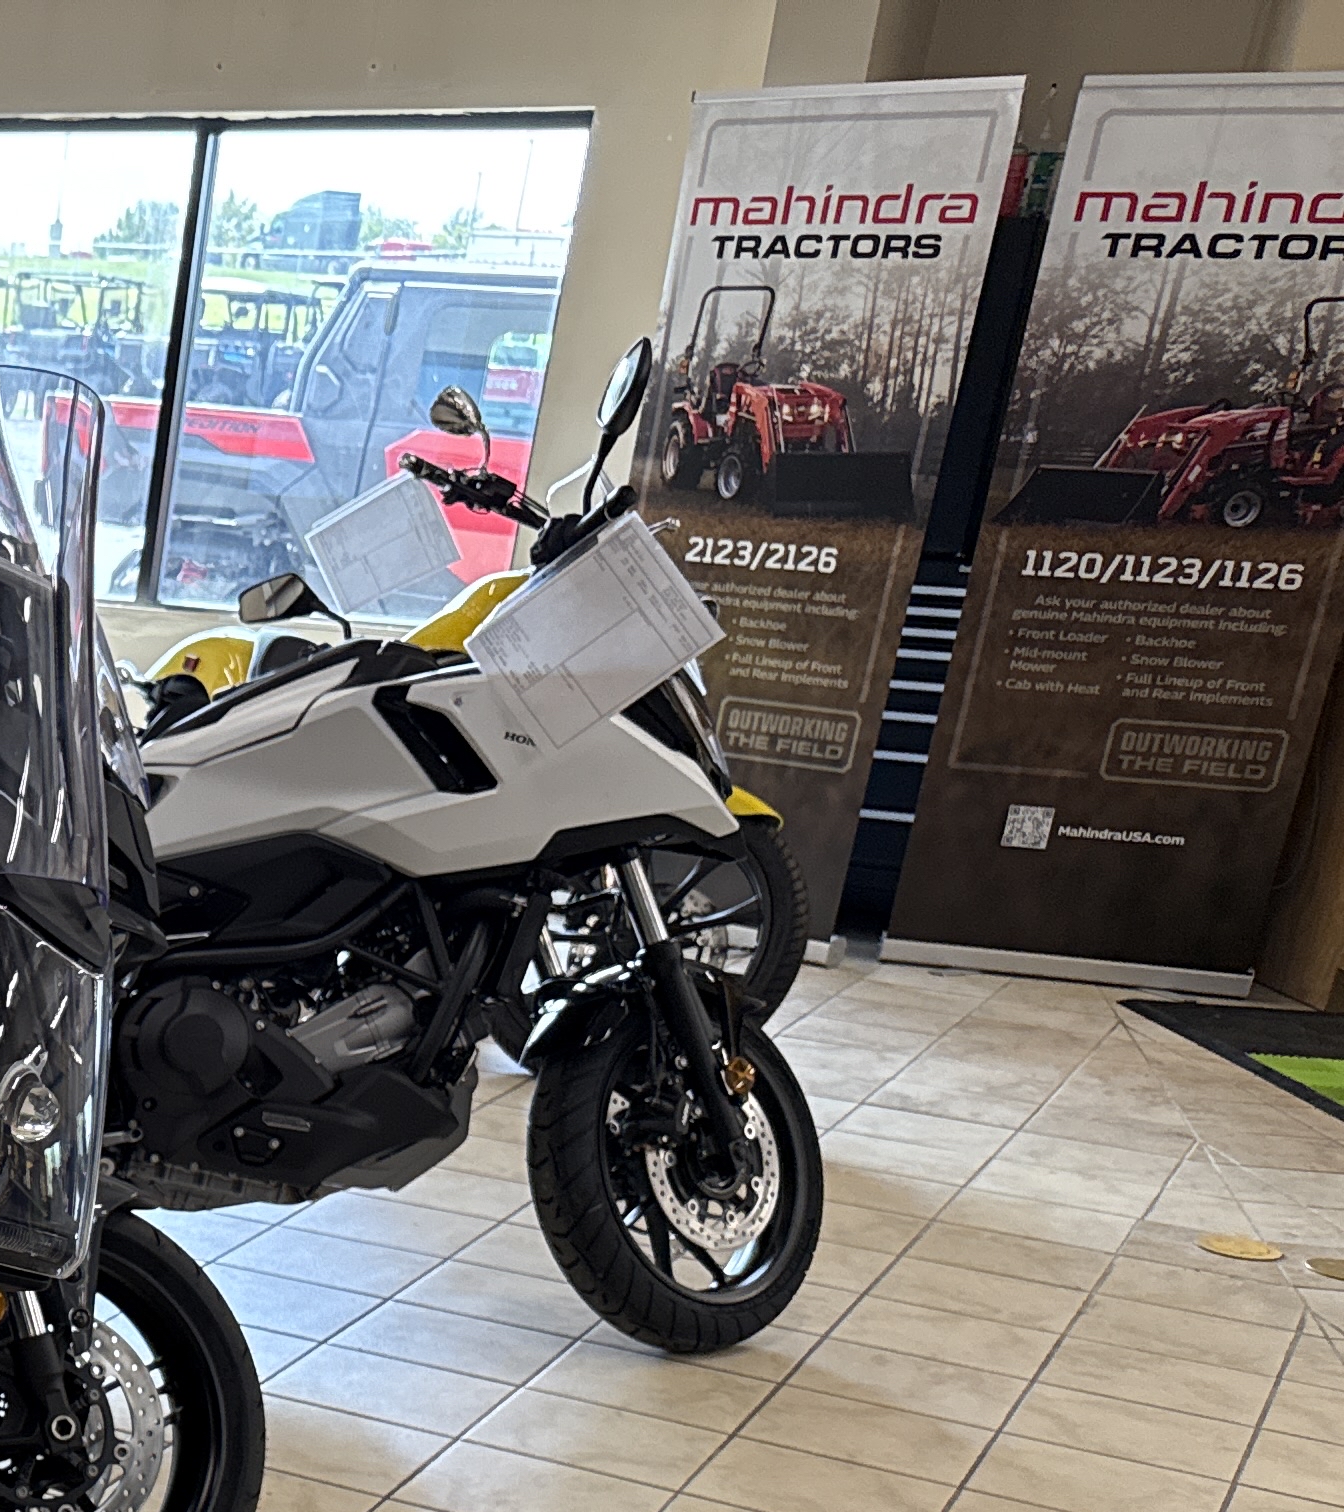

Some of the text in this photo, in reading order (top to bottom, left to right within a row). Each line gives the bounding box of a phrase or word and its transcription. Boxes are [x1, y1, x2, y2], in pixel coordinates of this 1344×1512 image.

[689, 183, 980, 226] mahindra
[711, 234, 943, 260] TRACTORS
[684, 535, 839, 575] 2123/2126
[1021, 549, 1305, 591] 1120/1123/1126
[711, 582, 772, 596] authorized
[773, 586, 812, 600] dealer
[812, 590, 847, 604] about
[741, 598, 802, 615] equipment
[1034, 594, 1272, 620] Ask your authorized dealer about
[739, 616, 787, 632] Backhoe
[1011, 608, 1068, 621] genuine
[1070, 610, 1136, 626] Mahindra
[1139, 615, 1217, 630] equipment
[735, 634, 810, 652] Snow Blower
[1017, 628, 1109, 644] Front Loader
[1134, 634, 1197, 649] Backhoe
[732, 652, 843, 675] Full Lineup of Front
[1013, 646, 1088, 662] Mid-mount
[1129, 653, 1224, 670] Snow Blower
[729, 667, 751, 678] and
[752, 668, 779, 681] Rear
[1009, 660, 1057, 673] Mower
[1005, 677, 1101, 696] Cab with Heat
[1125, 672, 1266, 693] Full Lineup of Front
[1122, 686, 1274, 708] and Rear Implements
[727, 708, 849, 743] OUTWORKING
[726, 729, 844, 760] THE FIELD
[1119, 730, 1273, 762] OUTWORKING
[1117, 753, 1267, 780] THE FIELD
[1057, 825, 1186, 847] MahindraUSA.com
